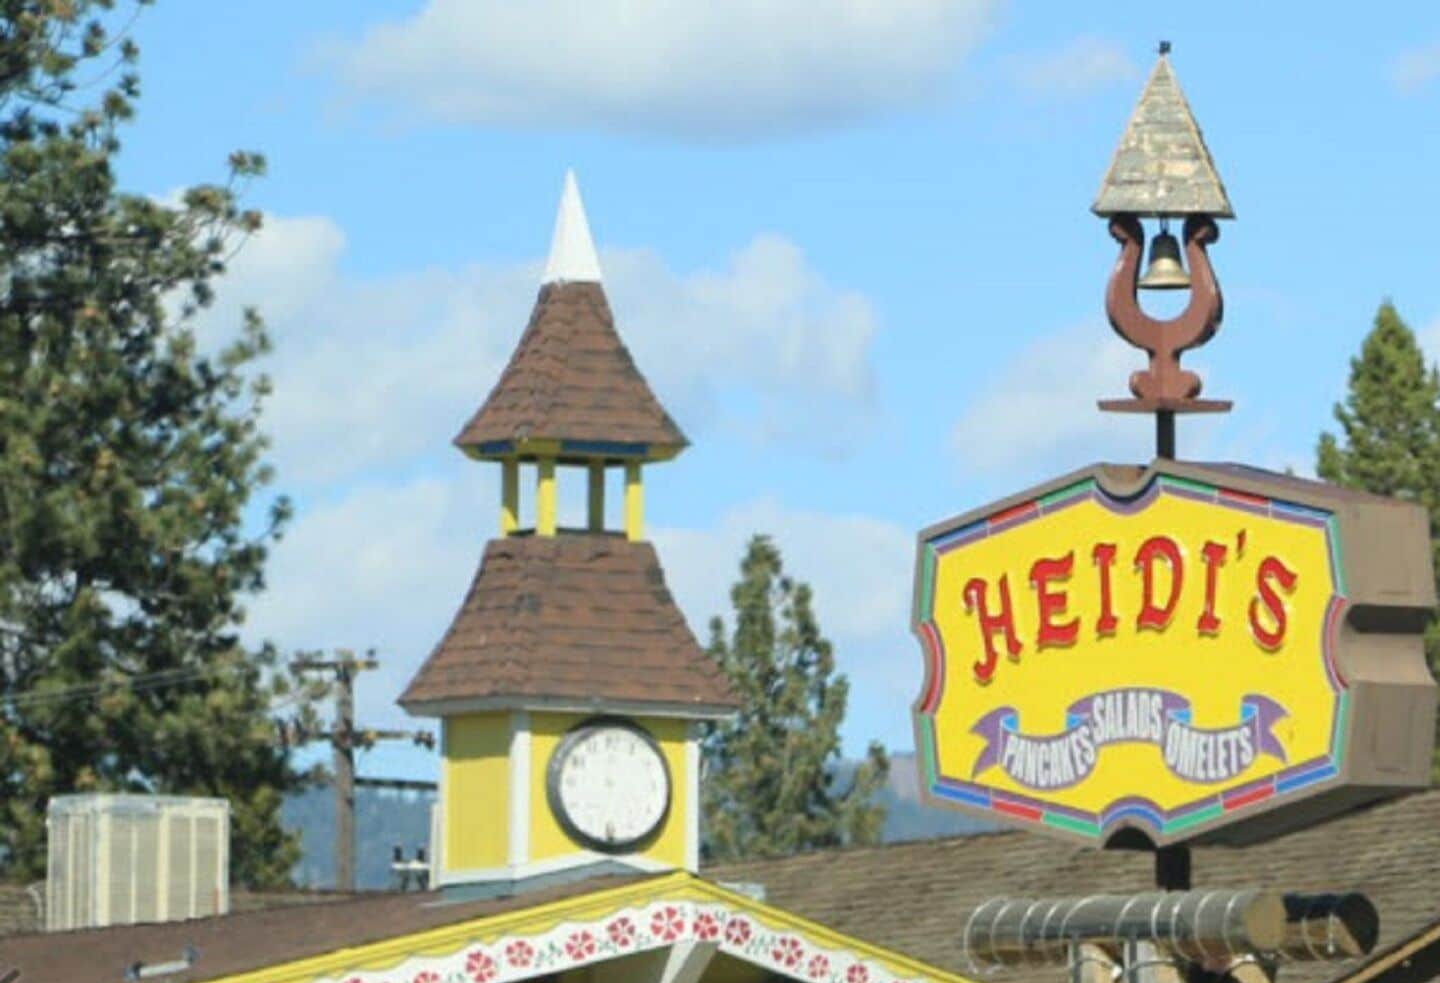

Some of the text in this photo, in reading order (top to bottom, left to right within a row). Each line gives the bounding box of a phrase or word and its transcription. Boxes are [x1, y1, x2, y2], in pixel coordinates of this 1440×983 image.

[963, 529, 1298, 685] HEIDI'S
[1002, 690, 1254, 787] PANCAKES SALADS OMELETS
